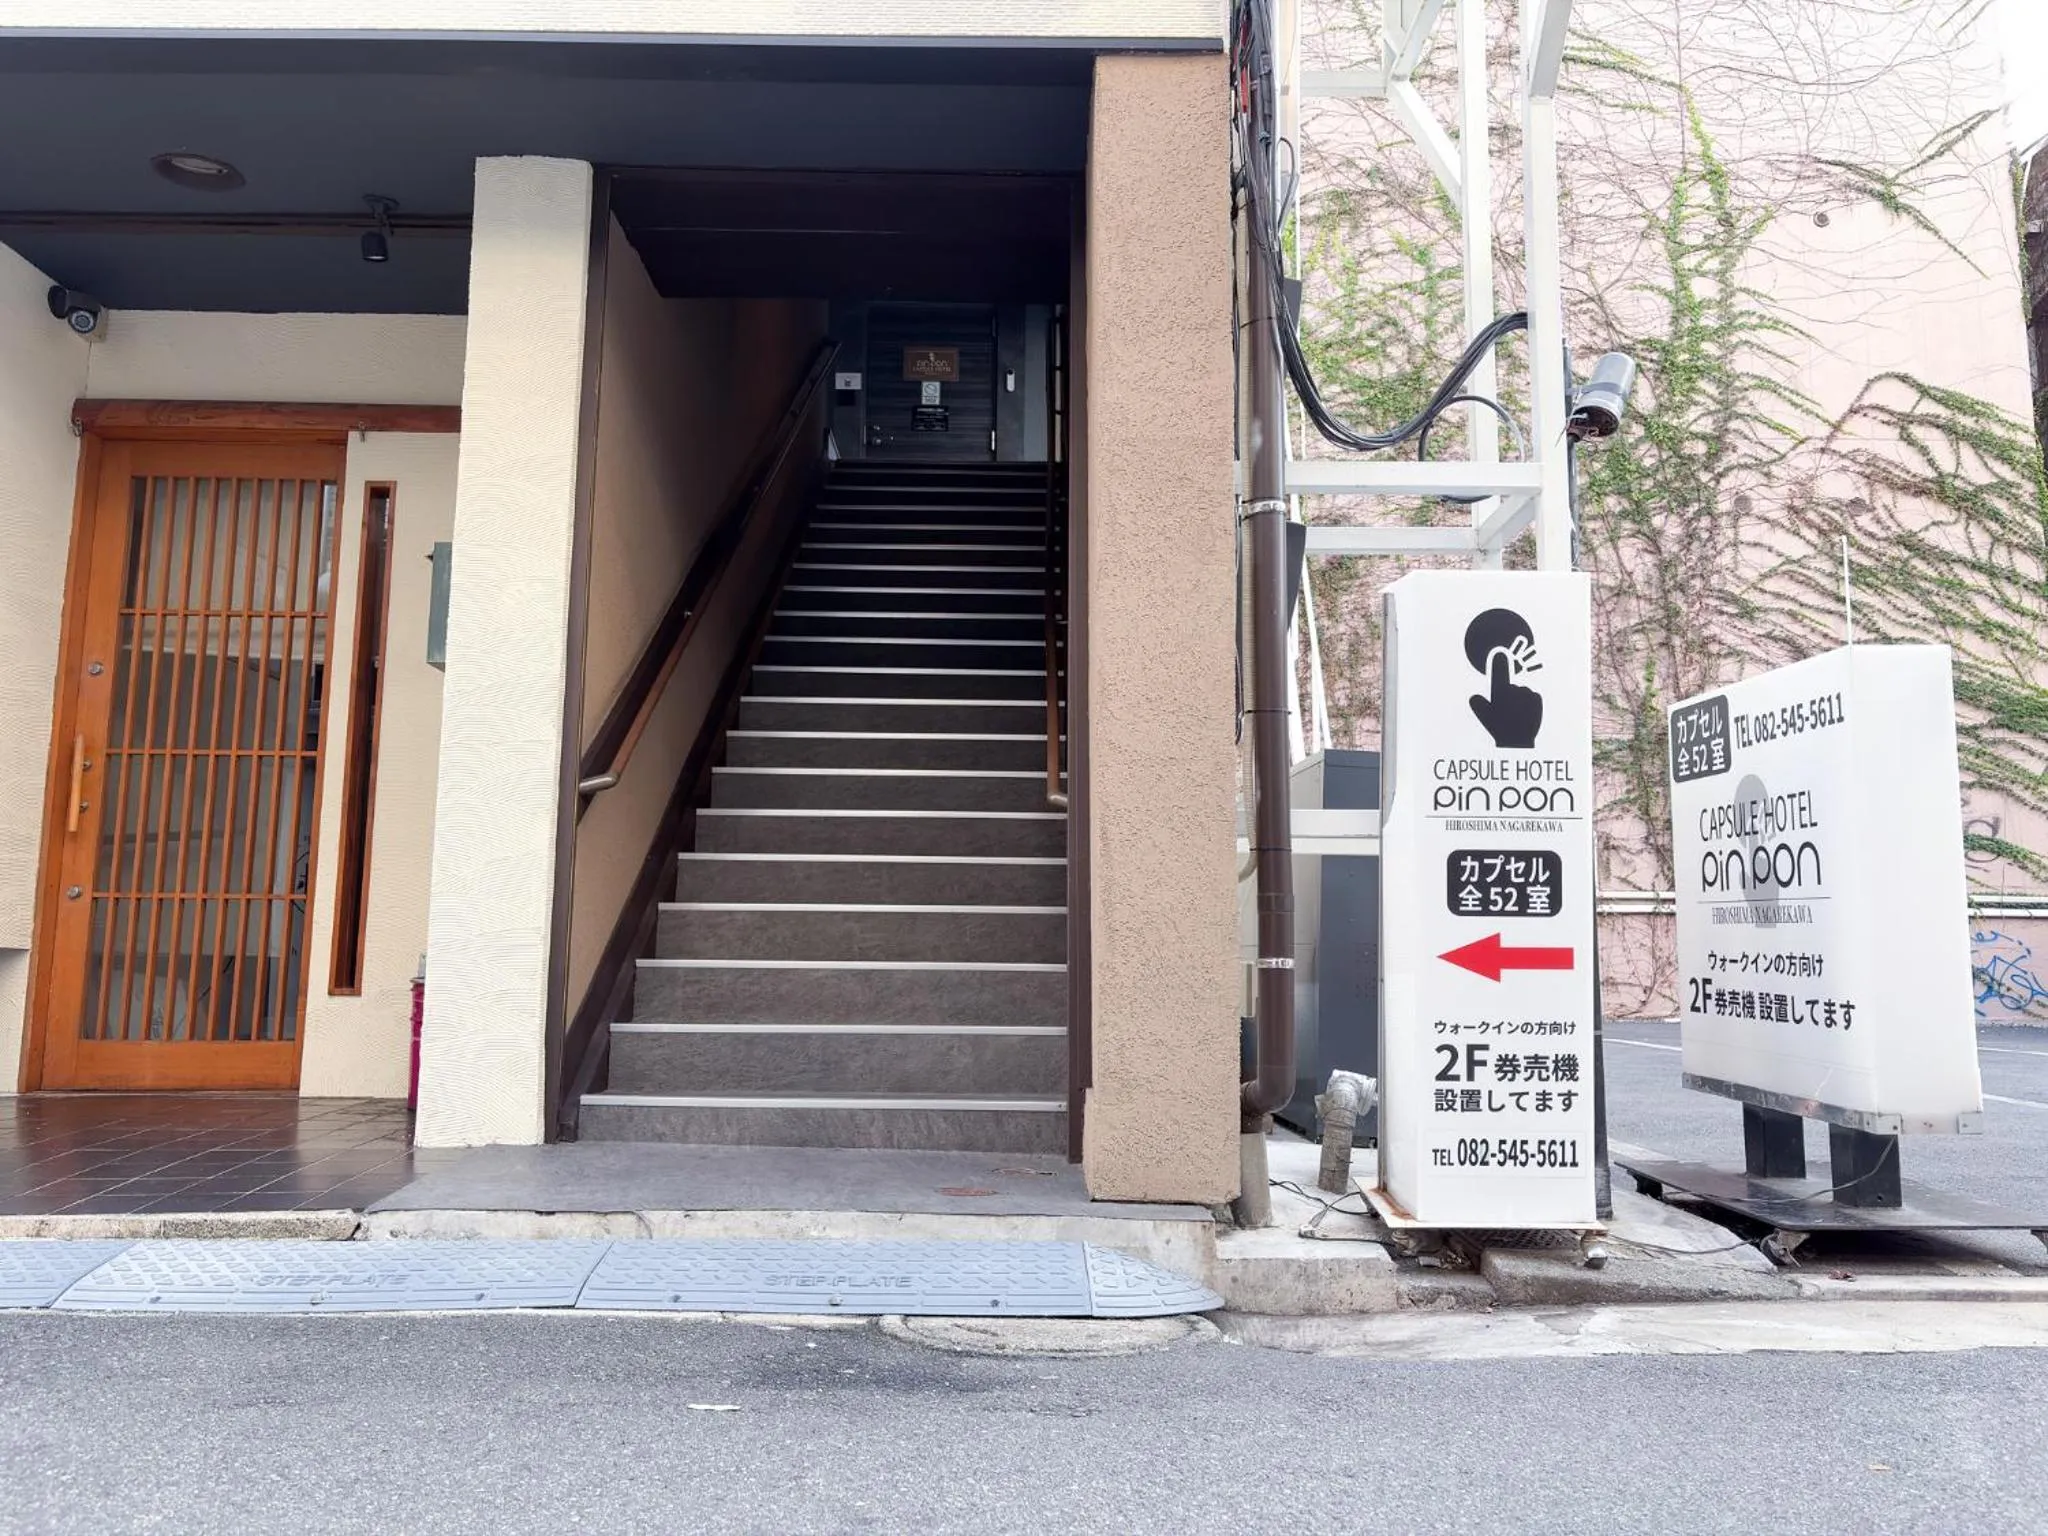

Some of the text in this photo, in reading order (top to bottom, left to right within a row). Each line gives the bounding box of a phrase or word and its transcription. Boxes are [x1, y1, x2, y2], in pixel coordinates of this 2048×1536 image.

[1677, 705, 1723, 744] カプセル
[1734, 692, 1845, 750] TEL 082-545-5611
[1433, 759, 1574, 781] CAPSULE HOTEL
[1434, 786, 1574, 812] pin pon
[1445, 820, 1563, 833] HIROSHIMA NAGAREKAWA
[1699, 790, 1818, 842] CAPSULE HOTEL
[1459, 855, 1551, 883] カプセル
[1702, 841, 1822, 893] pin pon
[1712, 905, 1754, 925] HIROSHIMA
[1708, 950, 1824, 978] ウォークインの方向け
[1434, 1020, 1577, 1036] ウォークインの方向け
[1433, 1088, 1579, 1113] 設置してます
[1432, 1138, 1579, 1168] TEL 082-545-5611
